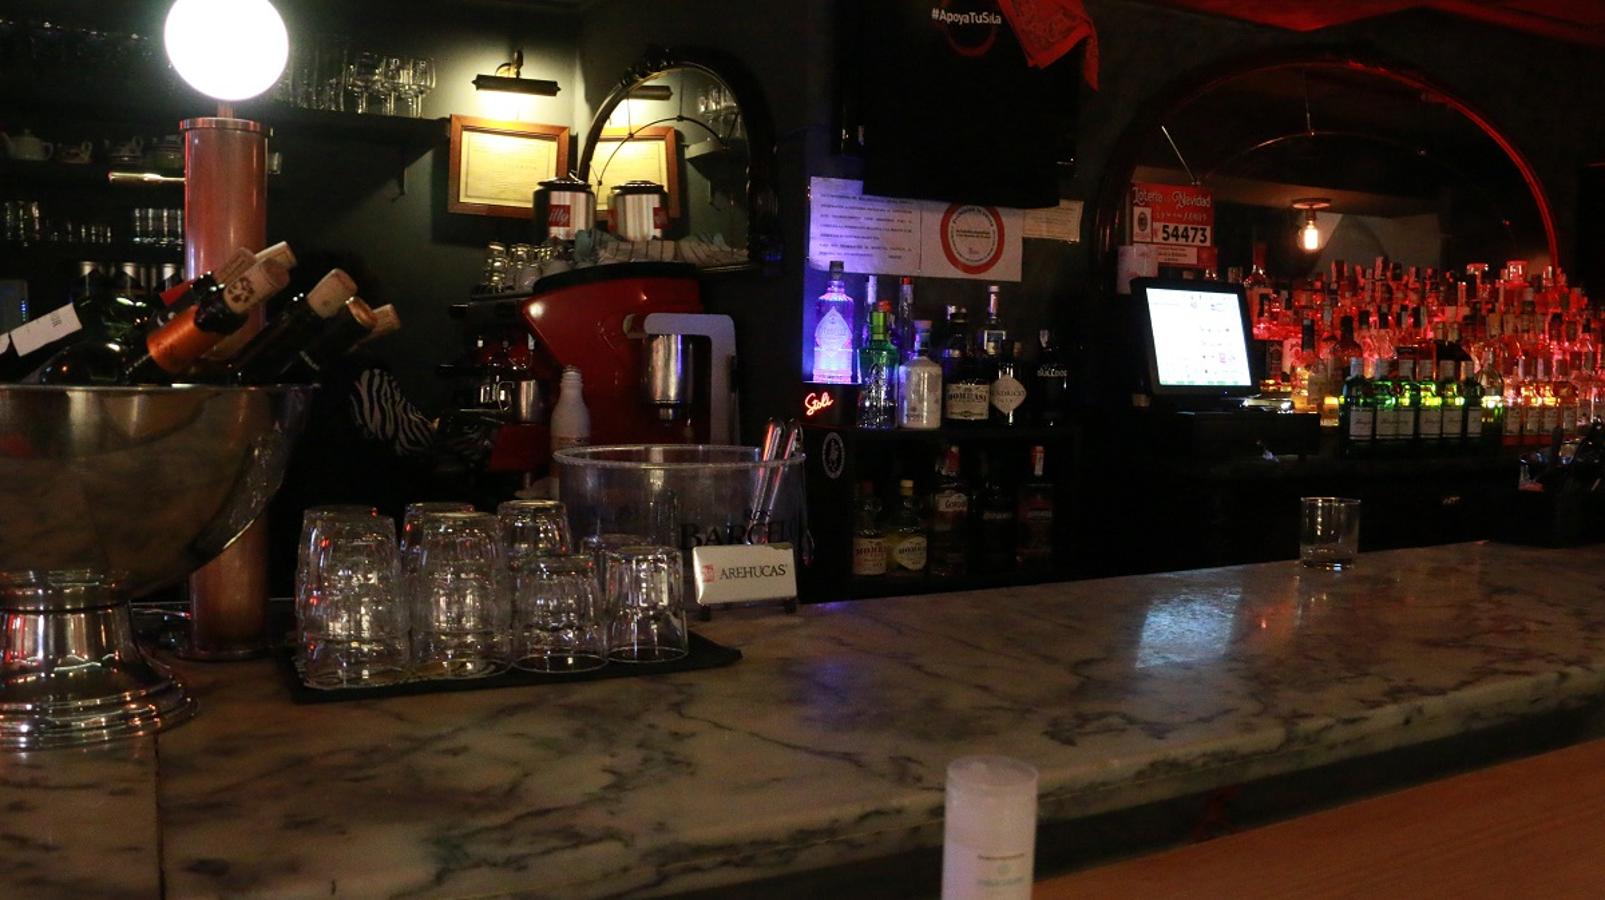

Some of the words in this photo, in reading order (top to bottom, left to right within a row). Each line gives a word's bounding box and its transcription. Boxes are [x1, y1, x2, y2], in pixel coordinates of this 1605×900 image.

[549, 207, 569, 225] illy
[1162, 224, 1207, 244] 54473
[804, 391, 834, 416] Stoli
[720, 563, 786, 580] AREHUCAS
